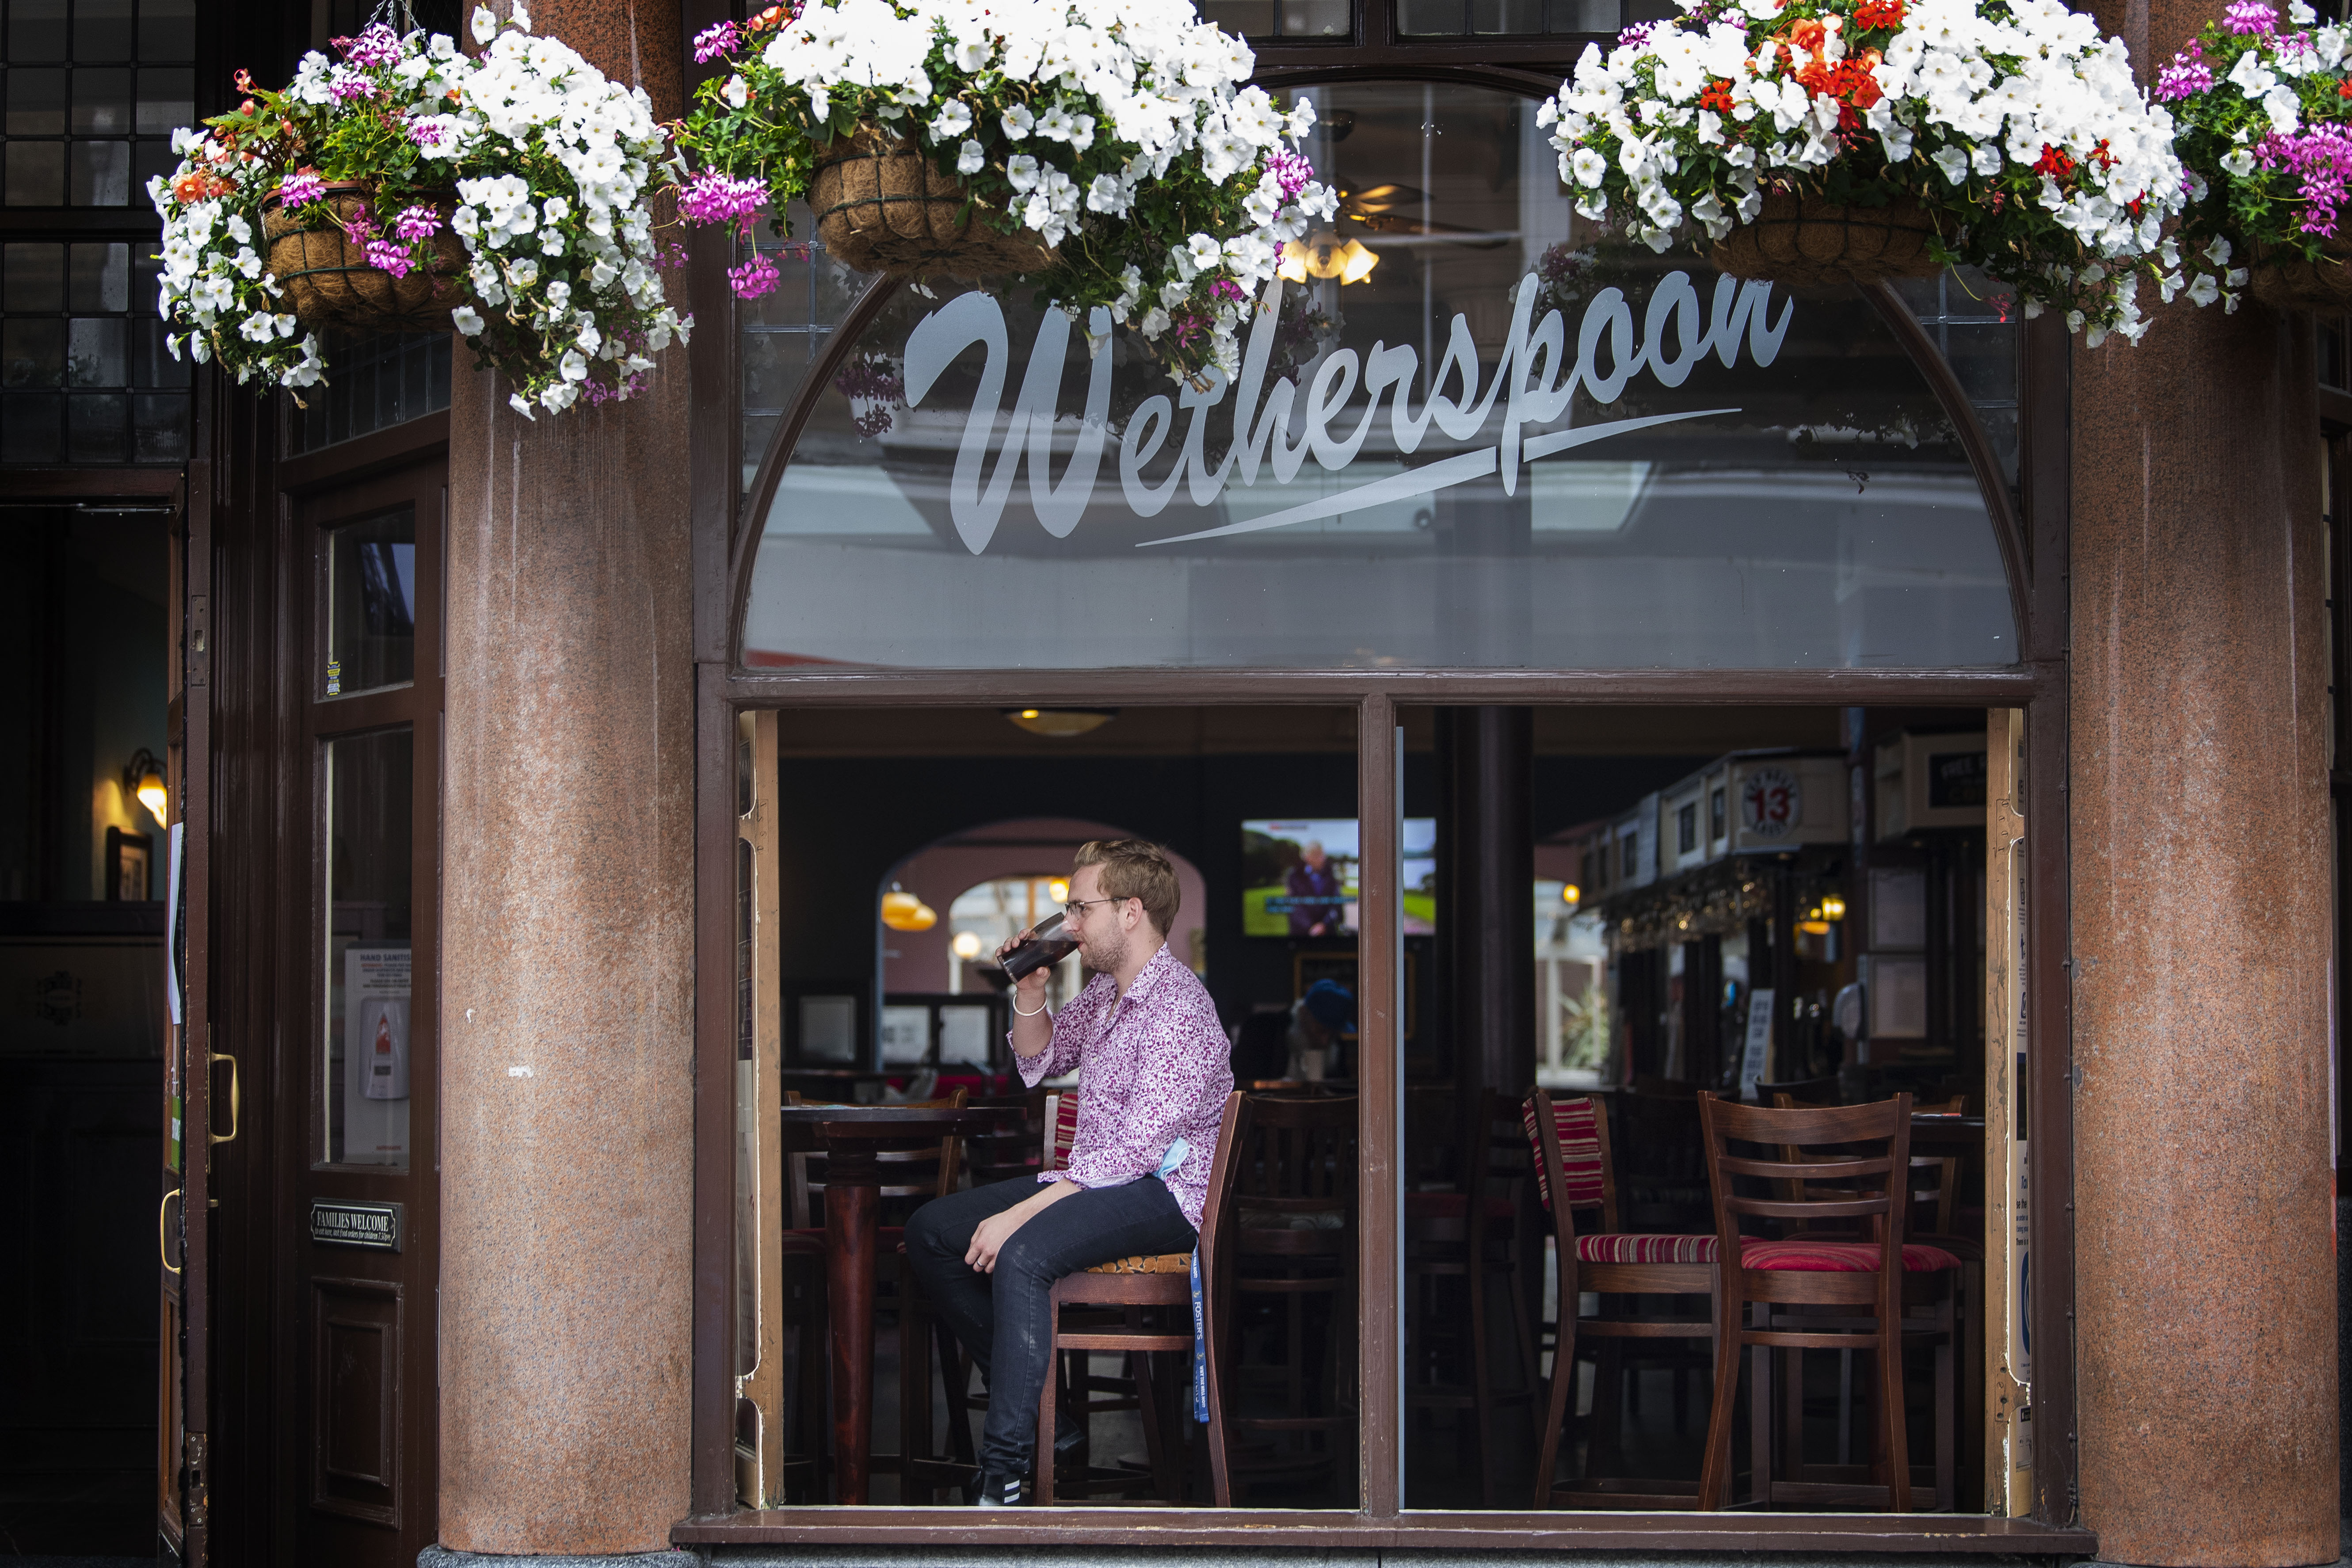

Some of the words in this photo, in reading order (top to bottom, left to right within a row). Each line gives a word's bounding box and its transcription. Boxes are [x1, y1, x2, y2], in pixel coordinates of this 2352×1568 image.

[903, 271, 1793, 555] Wetherspoon
[1753, 787, 1790, 821] 13
[317, 1211, 350, 1229] FAMILIES
[351, 1213, 389, 1232] WELCOME
[364, 1232, 378, 1240] children
[378, 1232, 391, 1242] 7.30pm
[1194, 1301, 1203, 1340] FOSTER'S
